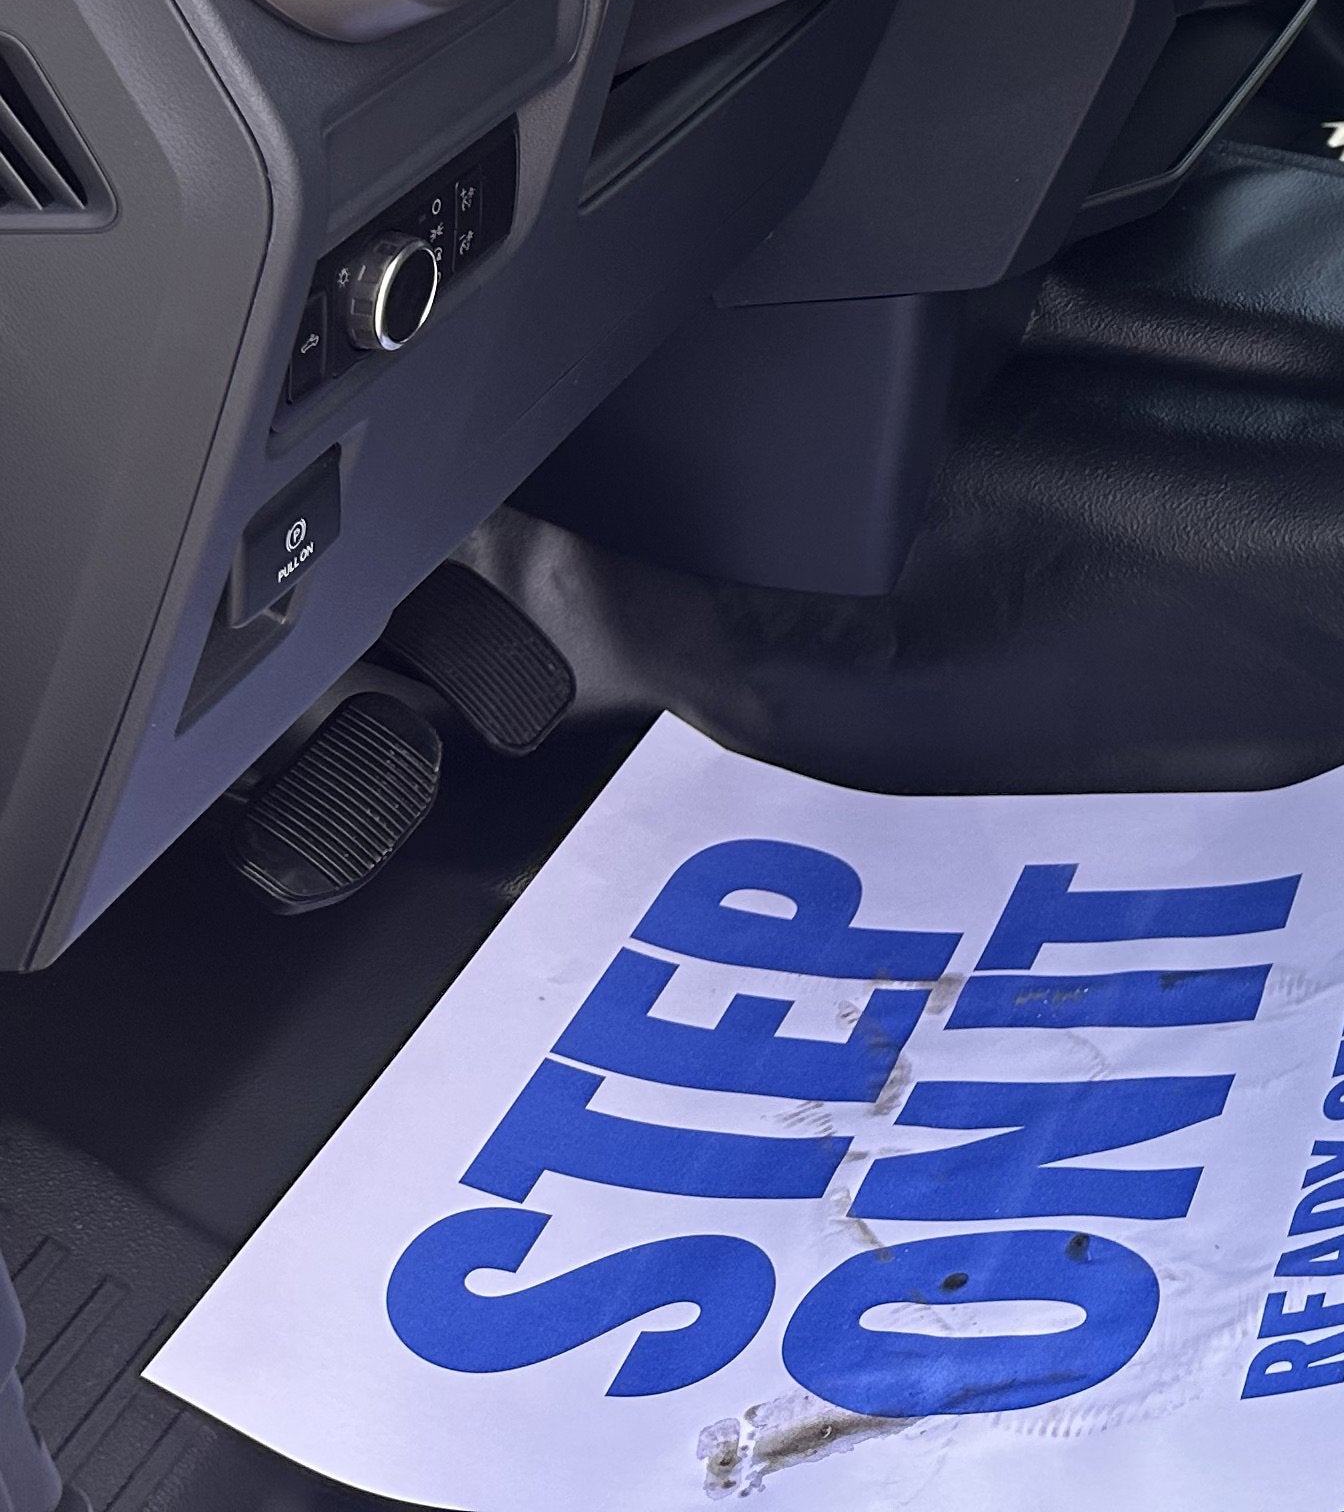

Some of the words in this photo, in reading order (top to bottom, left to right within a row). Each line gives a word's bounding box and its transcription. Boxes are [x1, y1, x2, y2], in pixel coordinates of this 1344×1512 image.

[277, 556, 300, 583] PULL
[300, 541, 314, 562] ON
[943, 863, 1302, 1031] IT
[386, 838, 964, 1397] STEP
[781, 1073, 1235, 1417] ON
